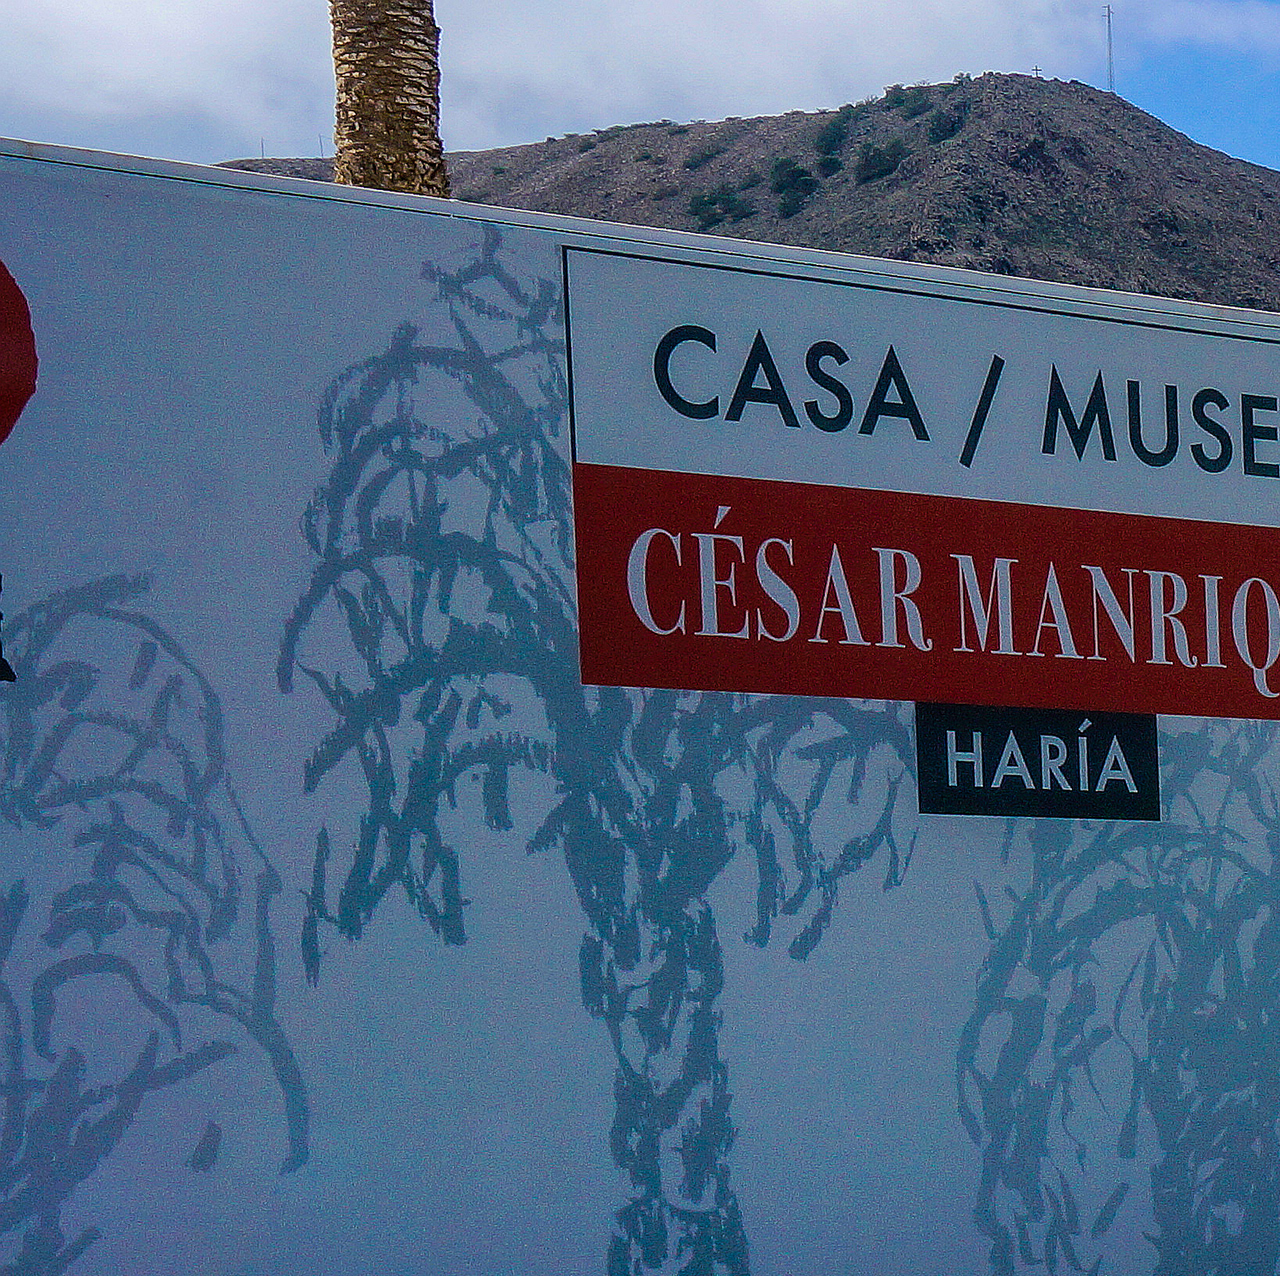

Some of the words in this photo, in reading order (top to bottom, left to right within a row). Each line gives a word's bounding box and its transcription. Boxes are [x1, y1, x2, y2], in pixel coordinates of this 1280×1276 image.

[652, 325, 930, 442] CASA
[626, 506, 933, 652] CÉSAR
[945, 719, 1139, 794] HARÍA
